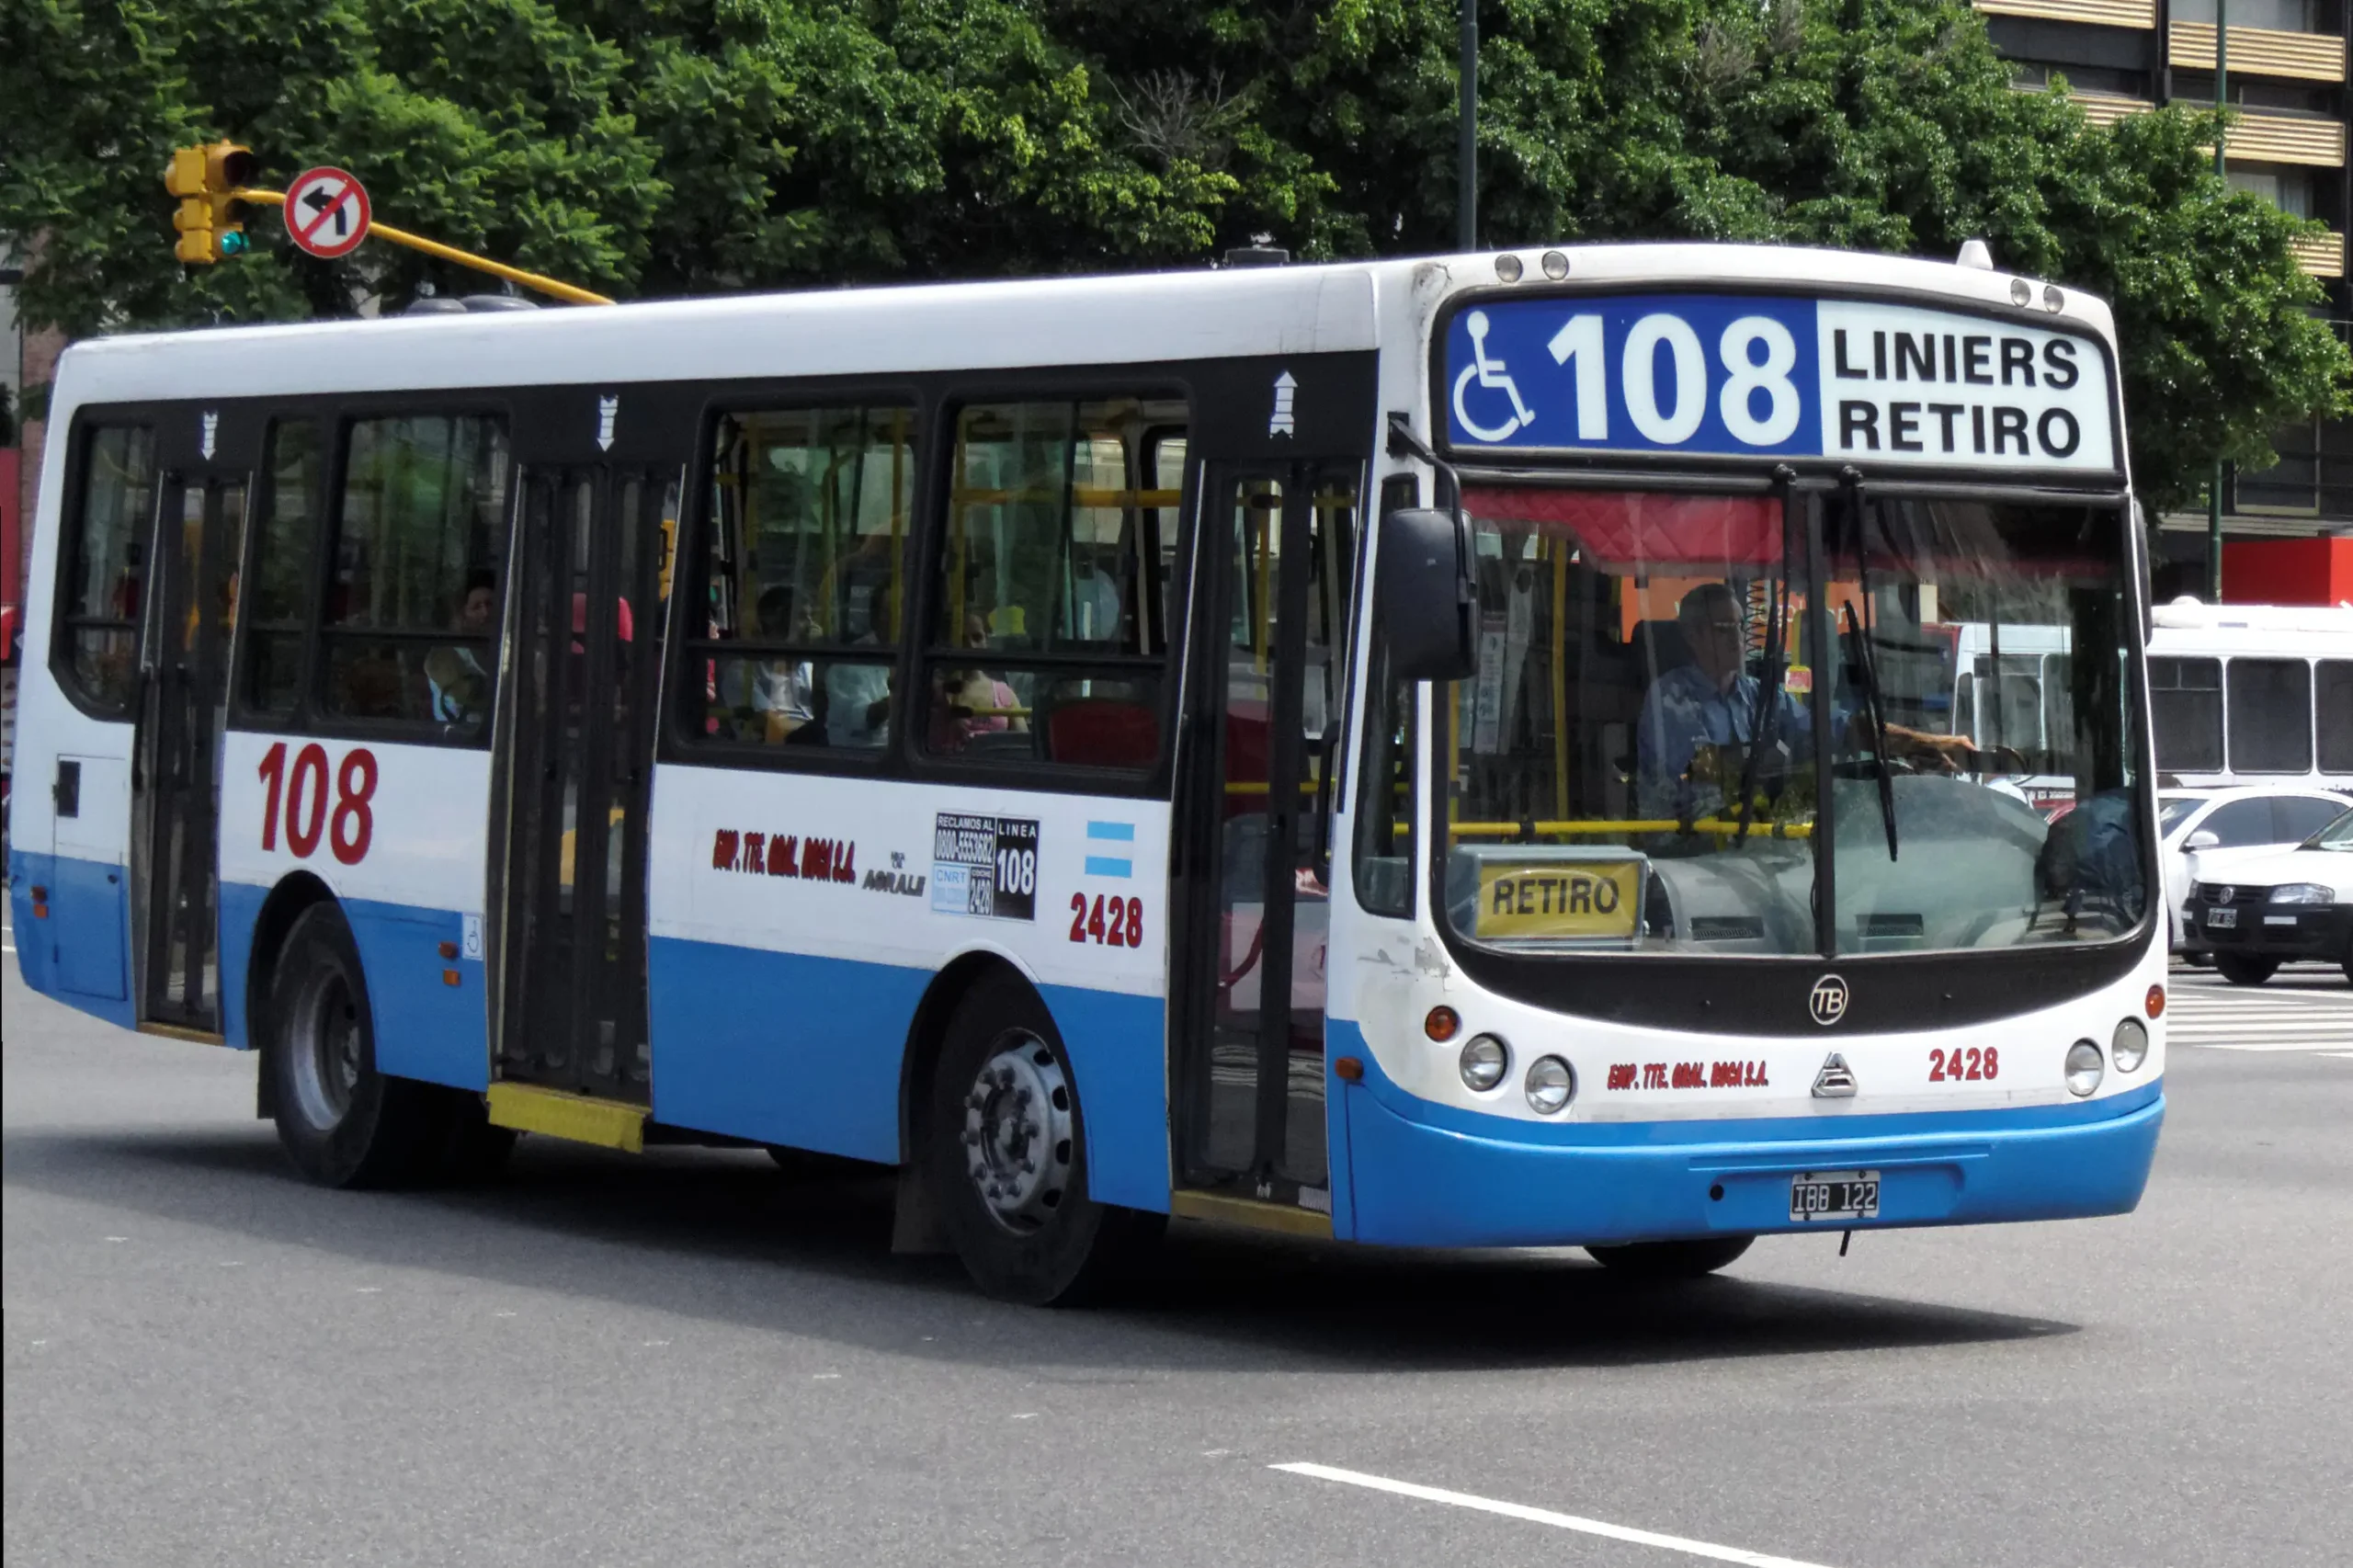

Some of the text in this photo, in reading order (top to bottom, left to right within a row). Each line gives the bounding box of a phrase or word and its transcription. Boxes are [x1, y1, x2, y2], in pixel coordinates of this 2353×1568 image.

[1834, 328, 2080, 391] LINIERS
[1546, 312, 1801, 446] 108
[1838, 400, 2081, 459] RETIRO
[258, 742, 379, 866] 108
[938, 815, 994, 831] RECLAMOS AL
[998, 824, 1037, 838] LINEA
[937, 869, 965, 883] CNRT
[997, 848, 1035, 895] 108
[970, 878, 991, 915] 2428
[1493, 877, 1620, 915] RETIRO
[1069, 892, 1142, 949] 2428
[1813, 988, 1844, 1014] TB
[1928, 1047, 1998, 1082] 2428
[1794, 1183, 1877, 1211] IBB 122
